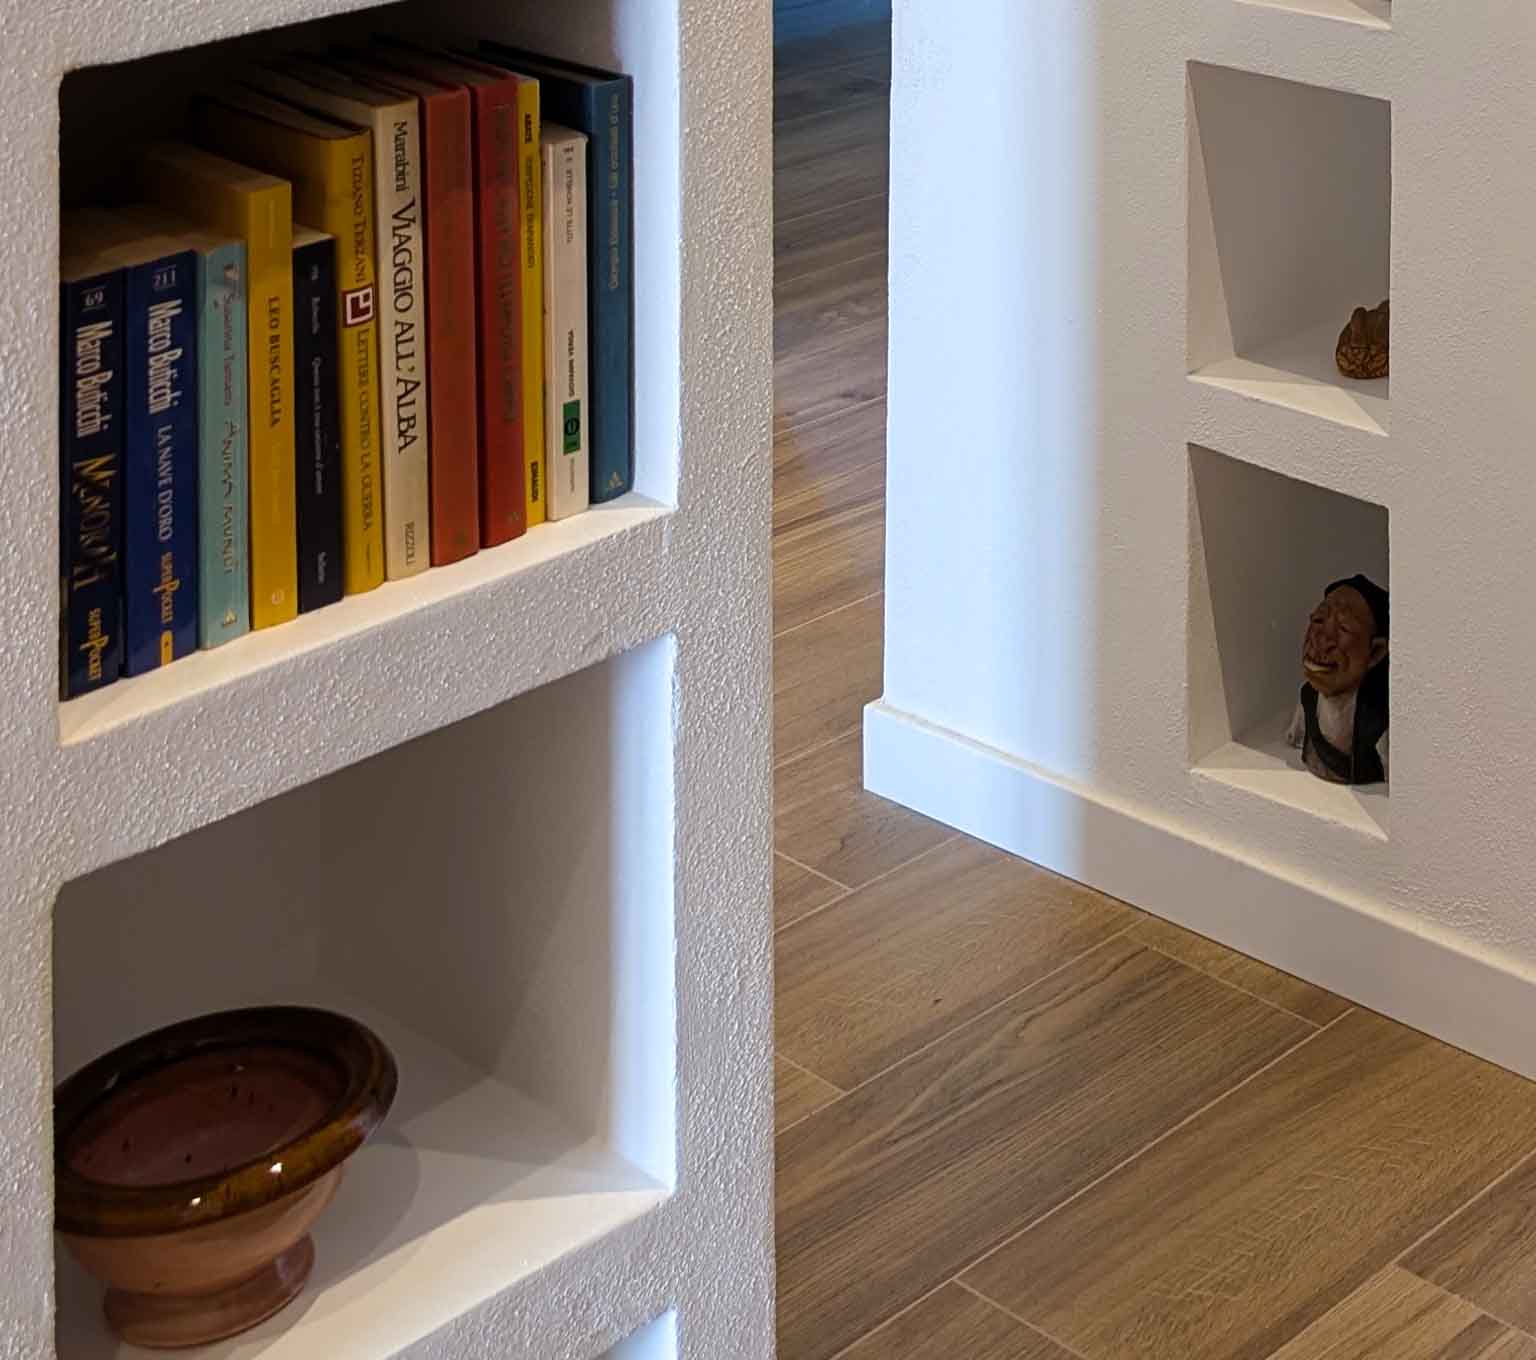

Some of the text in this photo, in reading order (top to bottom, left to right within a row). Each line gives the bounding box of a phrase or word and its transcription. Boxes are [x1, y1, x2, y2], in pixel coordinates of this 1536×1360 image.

[391, 198, 417, 314] VIAGGIO
[76, 320, 113, 374] Marco
[148, 298, 183, 353] Marco
[148, 347, 184, 415] Buticchi
[269, 295, 281, 429] LEO BUSCAGLIA
[394, 319, 422, 455] ALL'ALBA
[157, 423, 174, 543] LA NAVE D'ORO
